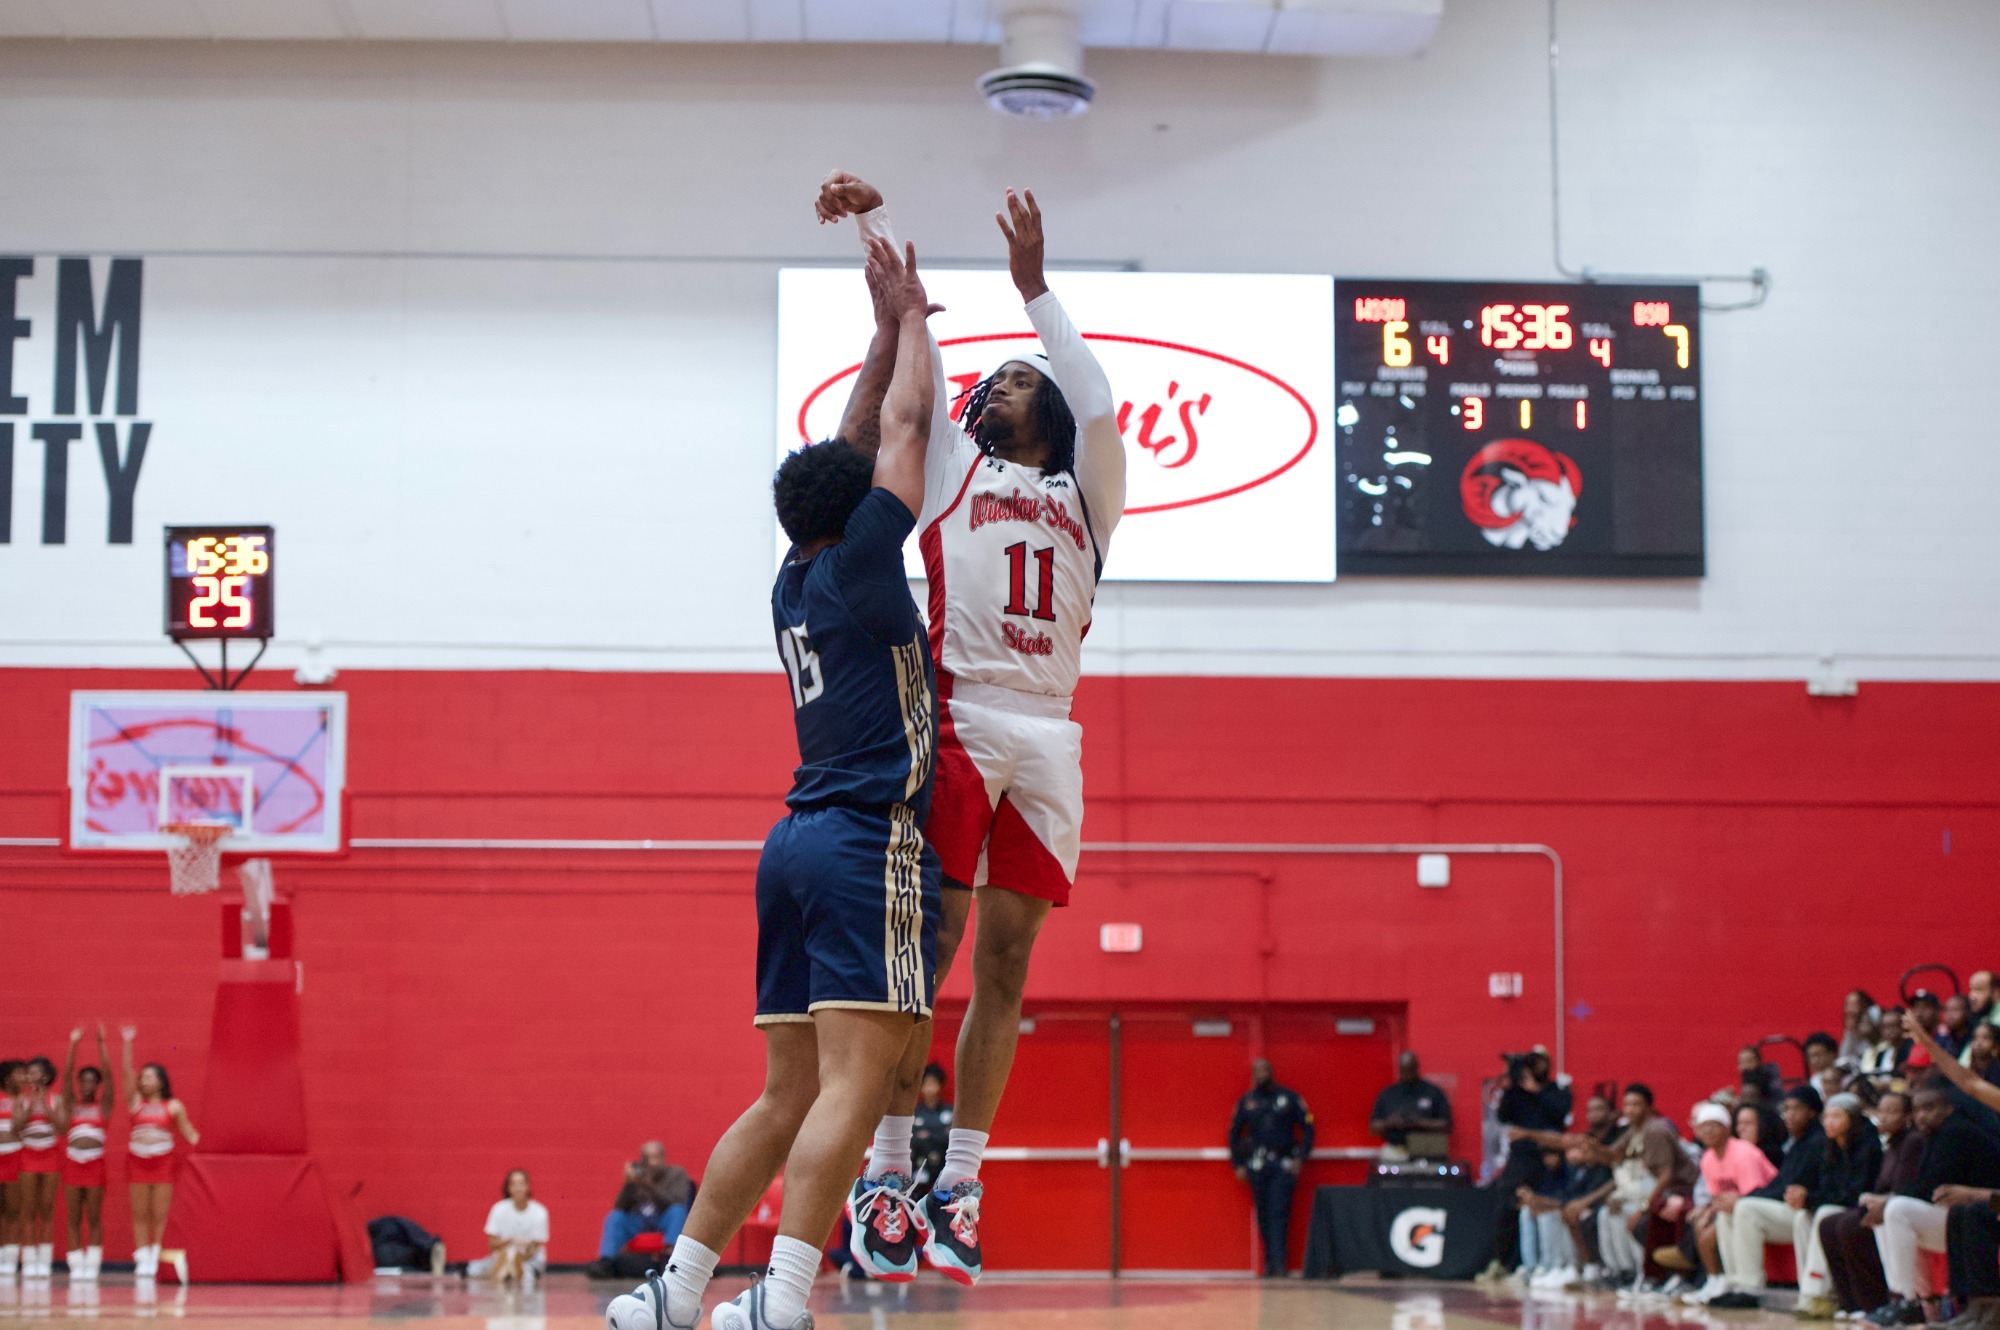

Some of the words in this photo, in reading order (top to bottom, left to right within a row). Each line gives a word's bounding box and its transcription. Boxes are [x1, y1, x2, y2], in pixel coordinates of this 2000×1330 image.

[1383, 321, 1412, 366] 6
[1481, 304, 1572, 349] 15:36
[1662, 325, 1690, 369] 7
[1426, 335, 1449, 365] 4
[1589, 338, 1612, 368] 4
[1463, 396, 1484, 430] 3
[1520, 399, 1531, 430] 1
[1575, 399, 1587, 430] 1
[187, 536, 268, 575] 15:36
[190, 576, 252, 628] 25
[1003, 541, 1056, 622] 11
[1002, 621, 1054, 656] State
[781, 620, 824, 710] 15
[1390, 1206, 1447, 1268] G
